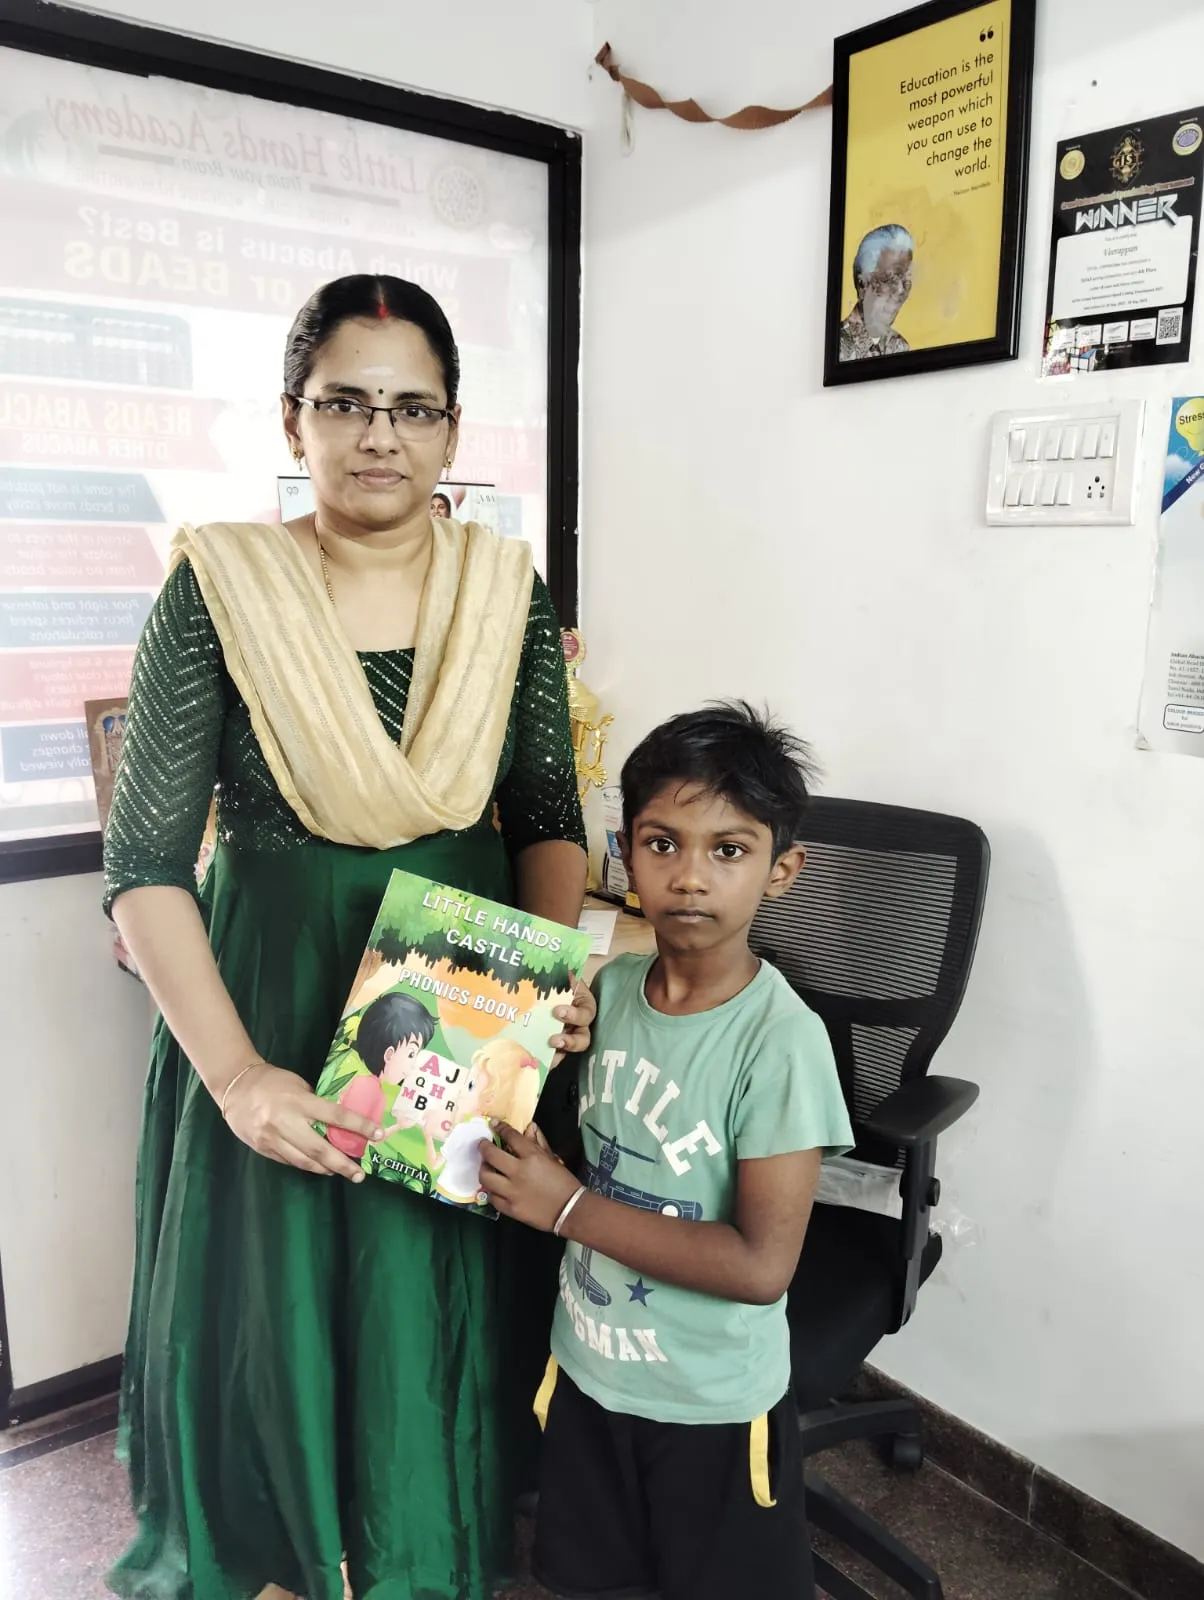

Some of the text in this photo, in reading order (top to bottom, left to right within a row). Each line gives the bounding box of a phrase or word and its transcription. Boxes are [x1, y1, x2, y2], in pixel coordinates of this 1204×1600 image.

[900, 52, 994, 95] Education is the
[909, 70, 993, 112] most powerful
[908, 92, 992, 131] weapon which
[907, 116, 992, 155] you can use to
[926, 137, 992, 166] change the
[955, 155, 991, 177] world.
[1075, 193, 1178, 233] WINNER
[1179, 411, 1204, 425] Stres
[422, 890, 563, 953] LITTLE HANDS
[446, 928, 524, 967] CASTLE
[399, 968, 532, 1027] PHONICS BOOK 1
[420, 1055, 440, 1077] A
[446, 1068, 460, 1083] J
[402, 1086, 416, 1100] M
[415, 1077, 425, 1088] Q
[429, 1083, 445, 1099] H
[414, 1094, 428, 1110] B
[445, 1100, 455, 1111] R
[372, 1153, 381, 1164] K
